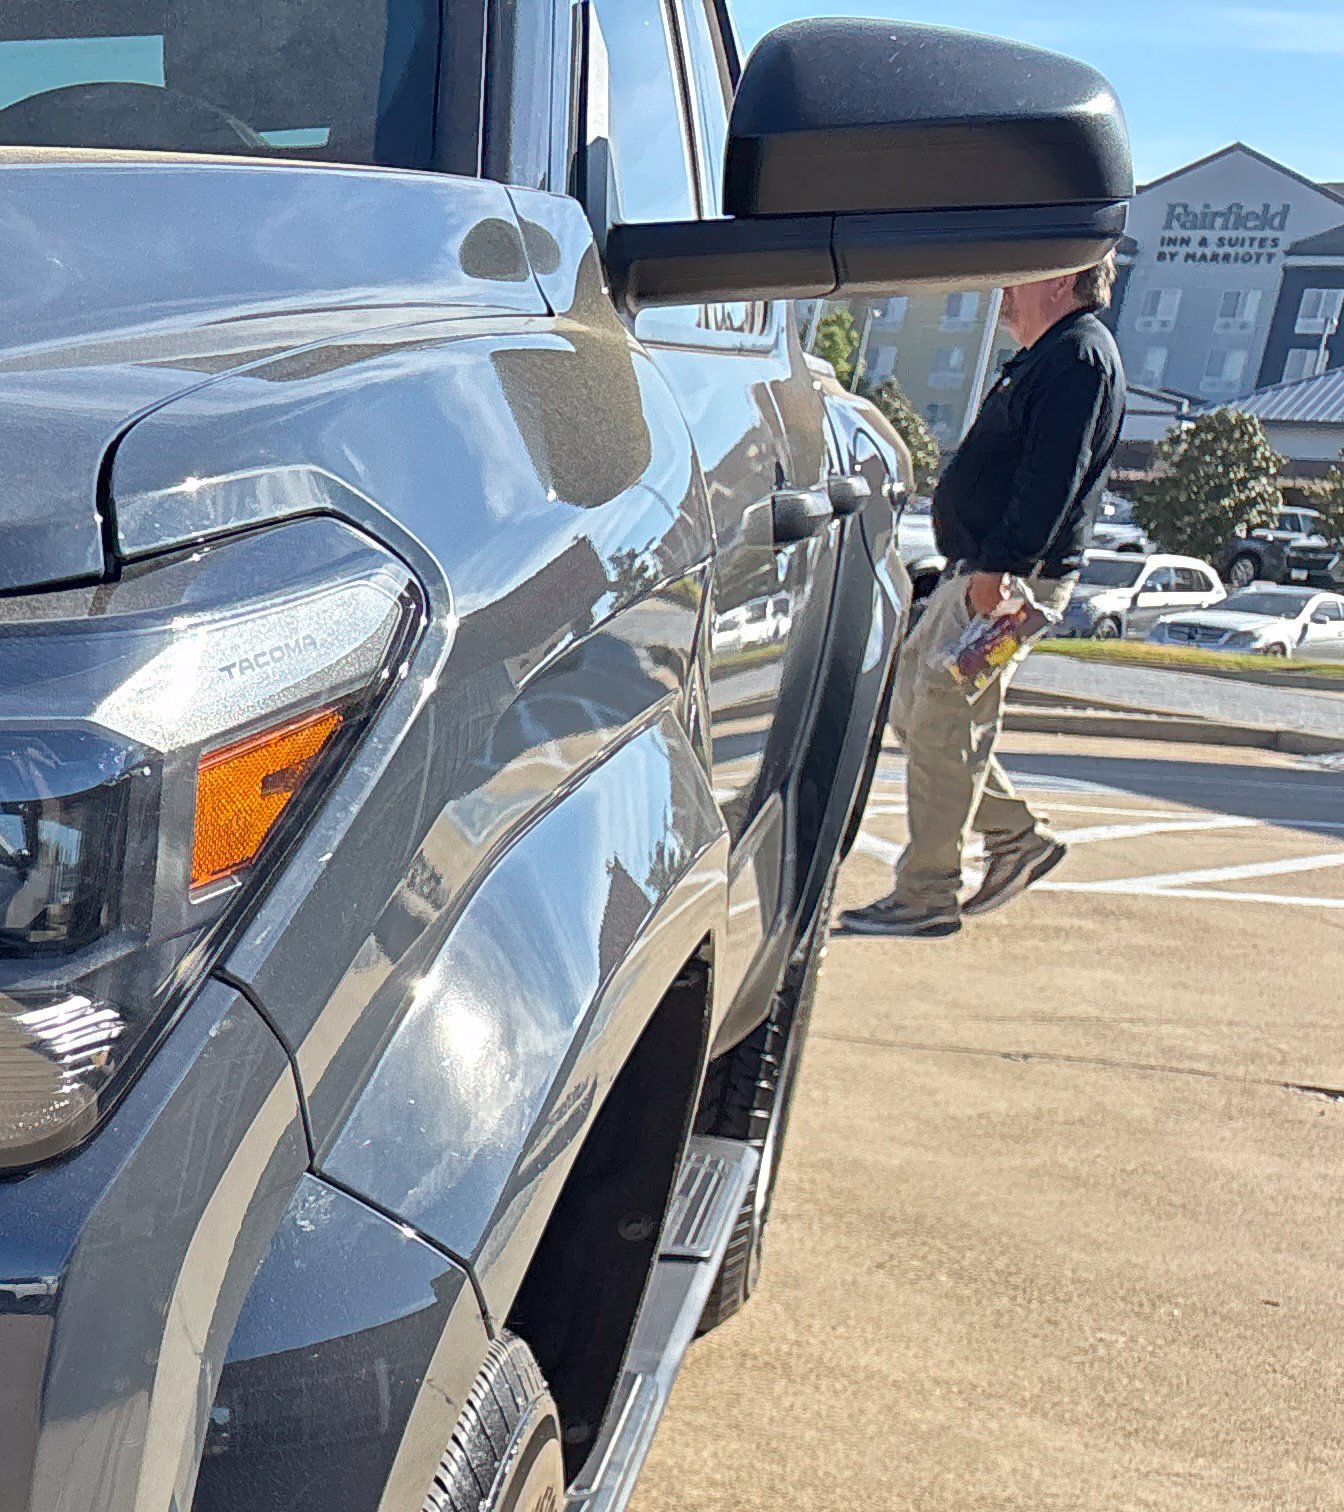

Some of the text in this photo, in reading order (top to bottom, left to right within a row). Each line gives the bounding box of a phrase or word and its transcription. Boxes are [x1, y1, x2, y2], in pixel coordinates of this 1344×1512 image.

[1162, 202, 1291, 231] Fairfield
[1159, 235, 1280, 248] INN & SUITES
[1156, 250, 1277, 264] BY MARRIOTT
[218, 633, 318, 680] TACOMA
